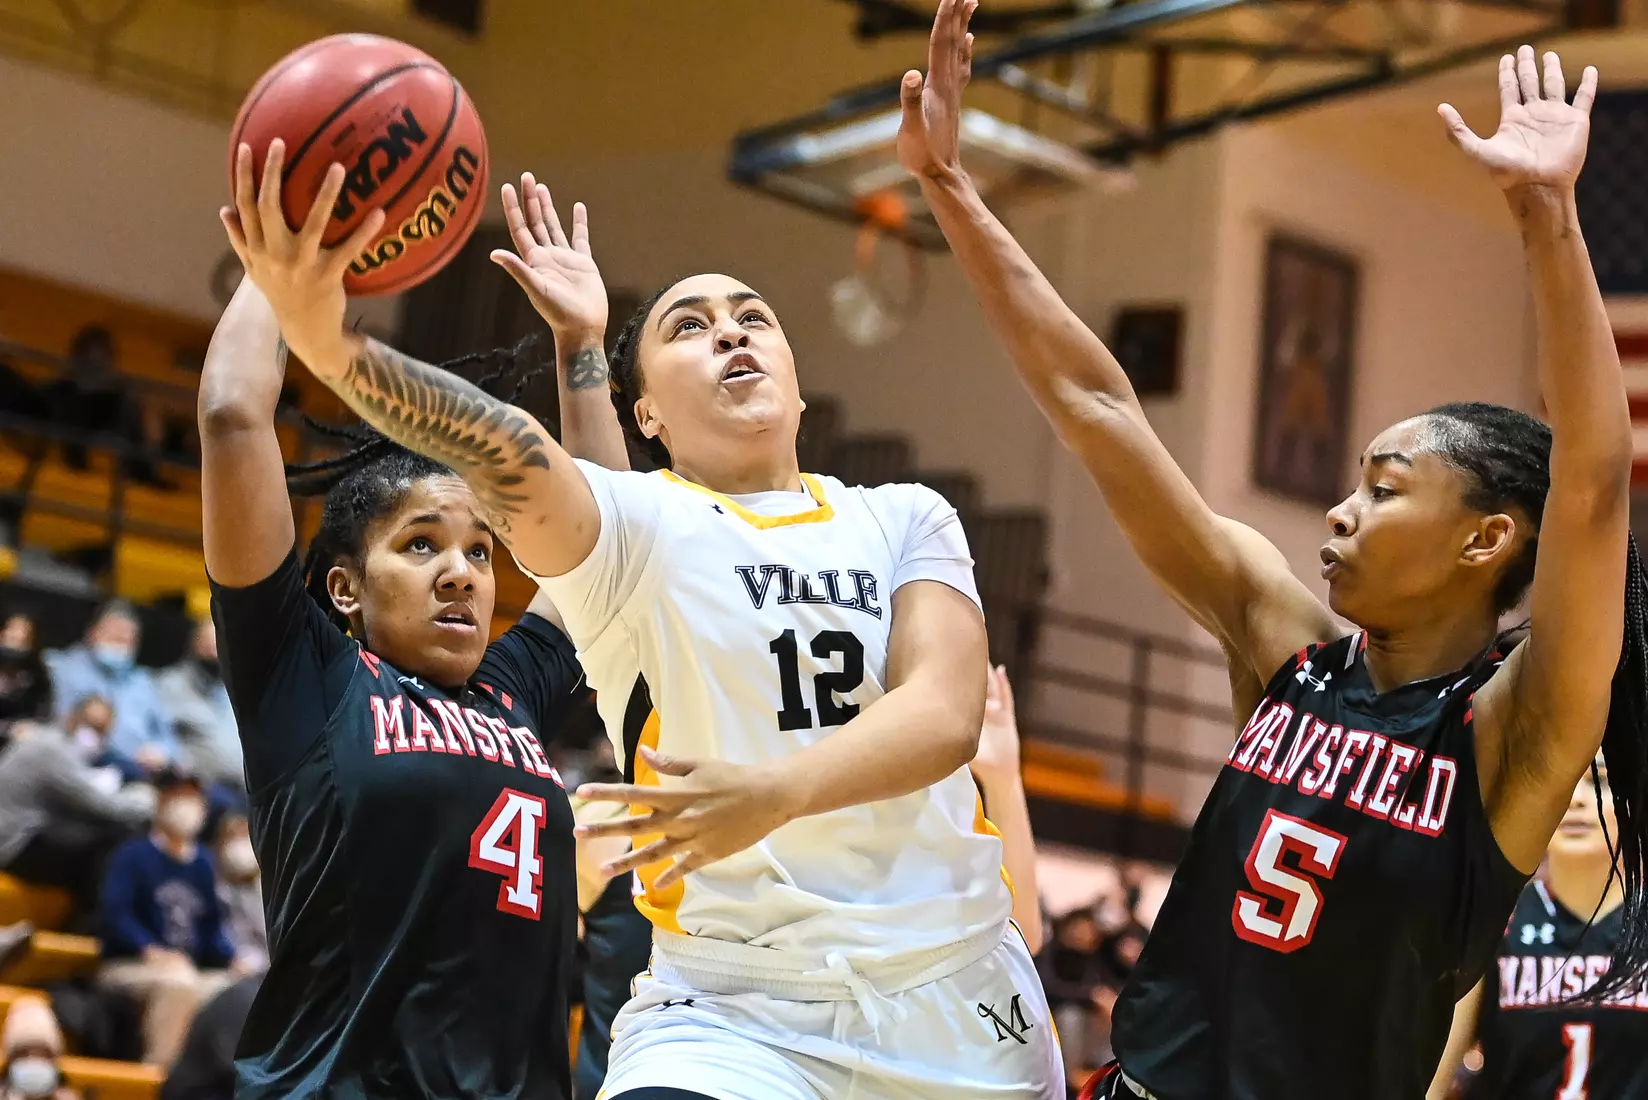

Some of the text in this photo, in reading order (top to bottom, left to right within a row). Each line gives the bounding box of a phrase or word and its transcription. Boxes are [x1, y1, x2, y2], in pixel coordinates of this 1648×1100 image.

[349, 146, 479, 275] Wilson
[735, 564, 882, 620] VILLE
[769, 629, 864, 731] 12
[1226, 696, 1458, 838] MANSFIELD
[468, 787, 546, 921] 4
[1231, 808, 1348, 953] 5
[1555, 1021, 1595, 1100] 1
